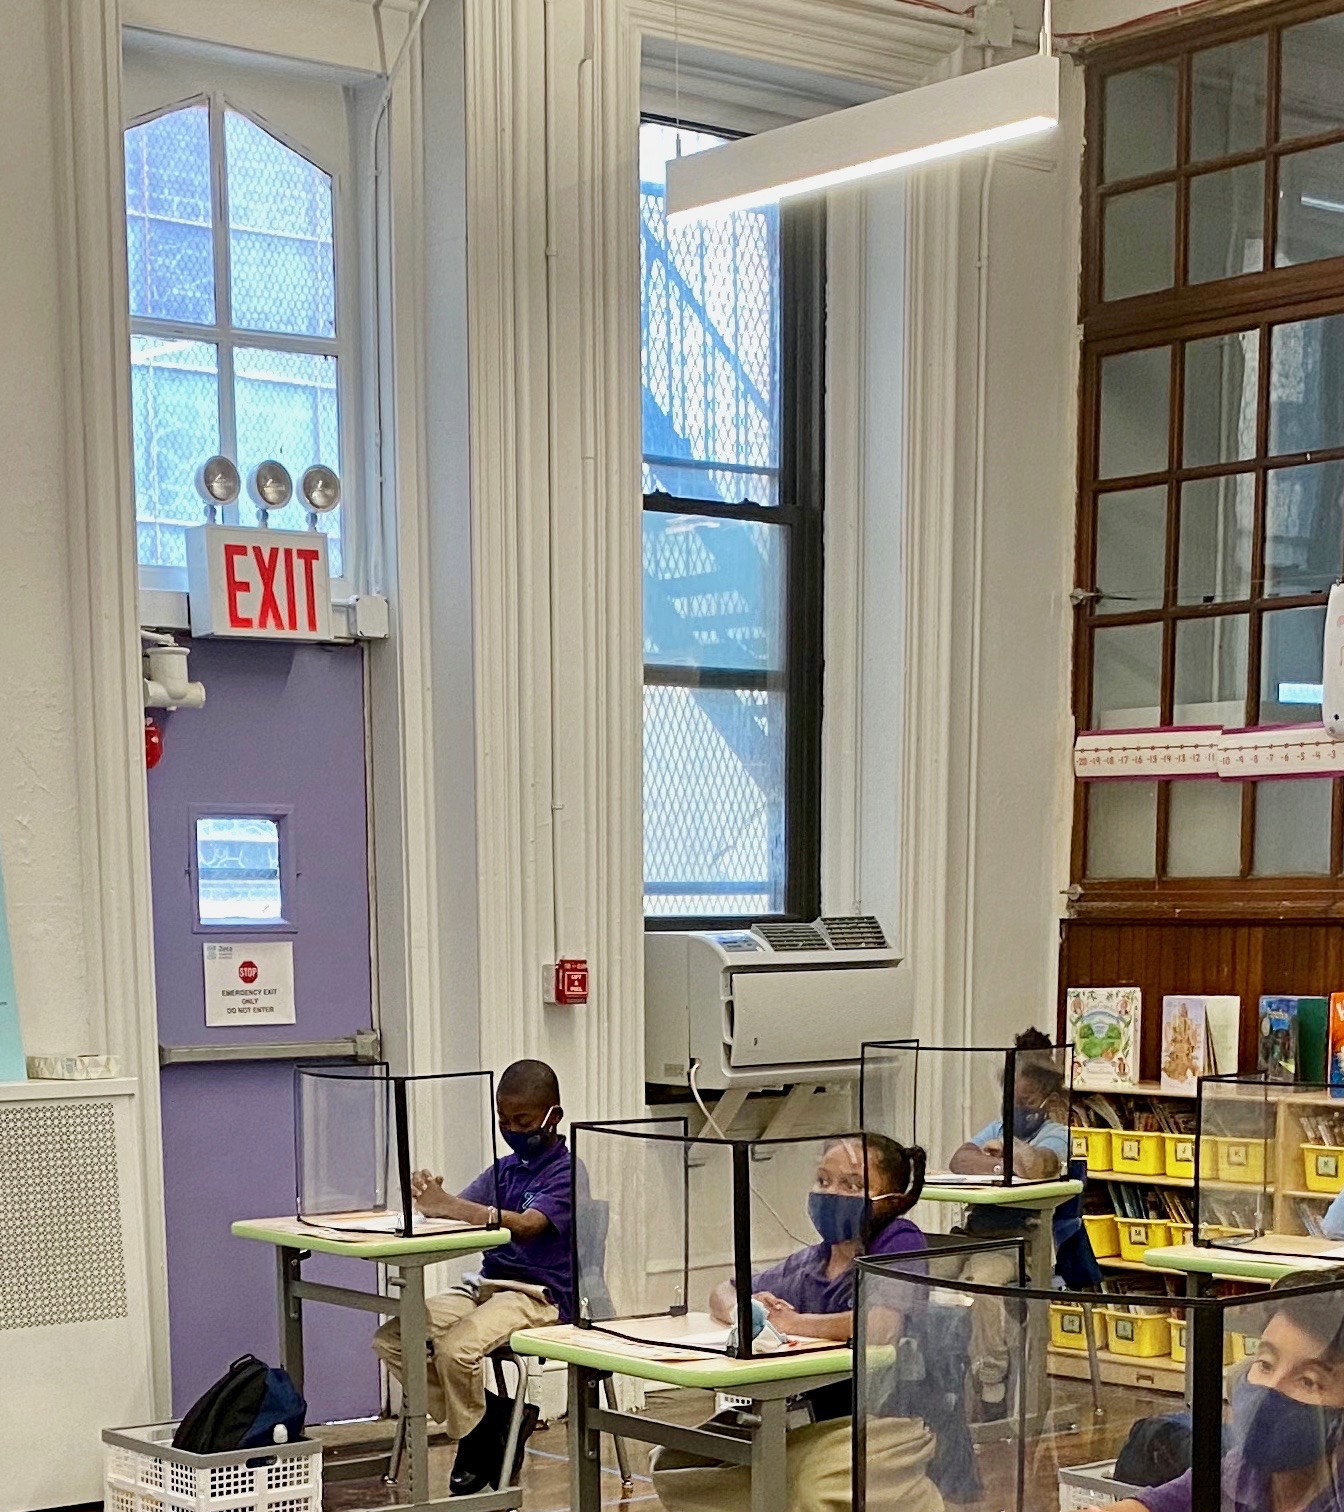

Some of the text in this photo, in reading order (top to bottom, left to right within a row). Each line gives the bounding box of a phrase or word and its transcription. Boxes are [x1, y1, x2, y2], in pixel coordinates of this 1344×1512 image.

[224, 543, 320, 632] EXIT
[239, 967, 257, 978] STOP
[222, 988, 277, 997] EMERGENCY EXIT
